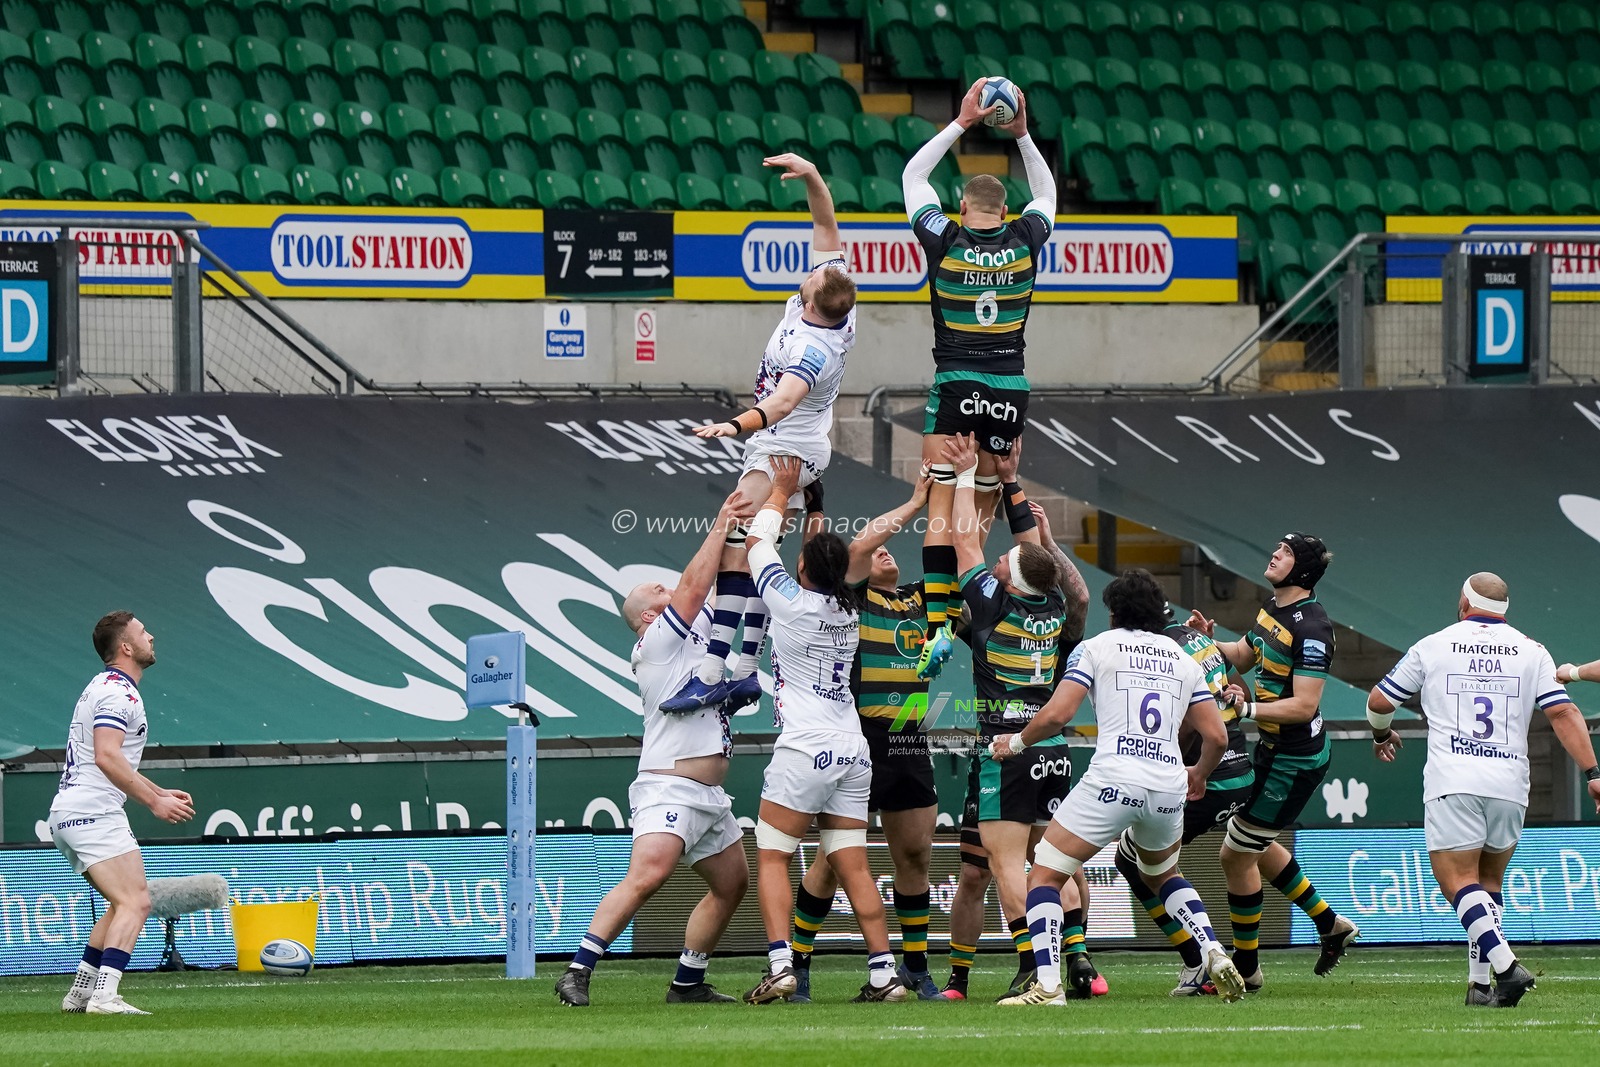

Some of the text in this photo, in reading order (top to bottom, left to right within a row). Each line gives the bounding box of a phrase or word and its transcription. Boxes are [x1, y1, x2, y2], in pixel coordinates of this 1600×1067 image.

[553, 231, 575, 241] BLOCK
[617, 231, 638, 242] SEATS
[277, 234, 466, 269] TOOLSTATION
[557, 245, 572, 279] 7
[749, 241, 922, 274] TOOLATION
[1, 261, 39, 273] TERRACE
[963, 270, 1014, 285] ISIEKWE
[1484, 273, 1516, 285] TERRACE
[975, 290, 998, 327] 6
[2, 288, 39, 353] D
[1485, 297, 1516, 356] D
[549, 332, 581, 345] Gangway
[547, 345, 564, 356] keep
[960, 391, 1018, 423] cinch
[46, 415, 282, 462] ELONEX
[1026, 408, 1400, 467] MIRUS
[1020, 637, 1054, 650] WALLER
[1117, 643, 1180, 660] THATCHERS
[1451, 642, 1519, 656] THATCHERS
[1030, 652, 1045, 684] 1
[1129, 655, 1175, 676] LUATUA
[1468, 658, 1502, 673] AFOA
[471, 671, 514, 684] Gallagher
[1130, 678, 1172, 691] HARTLEY
[1461, 682, 1506, 692] HARTLEY
[1140, 692, 1162, 735] 6
[1472, 696, 1495, 740] 3
[1117, 735, 1162, 752] Poplar
[837, 756, 856, 766] BS3
[1117, 744, 1177, 766] Insulation
[1030, 754, 1072, 780] cinch
[1121, 797, 1145, 808] BS3
[1348, 850, 1548, 915] Galler
[407, 861, 566, 941] Rugy
[1177, 907, 1206, 942] BEARS
[1050, 919, 1059, 963] BEARS
